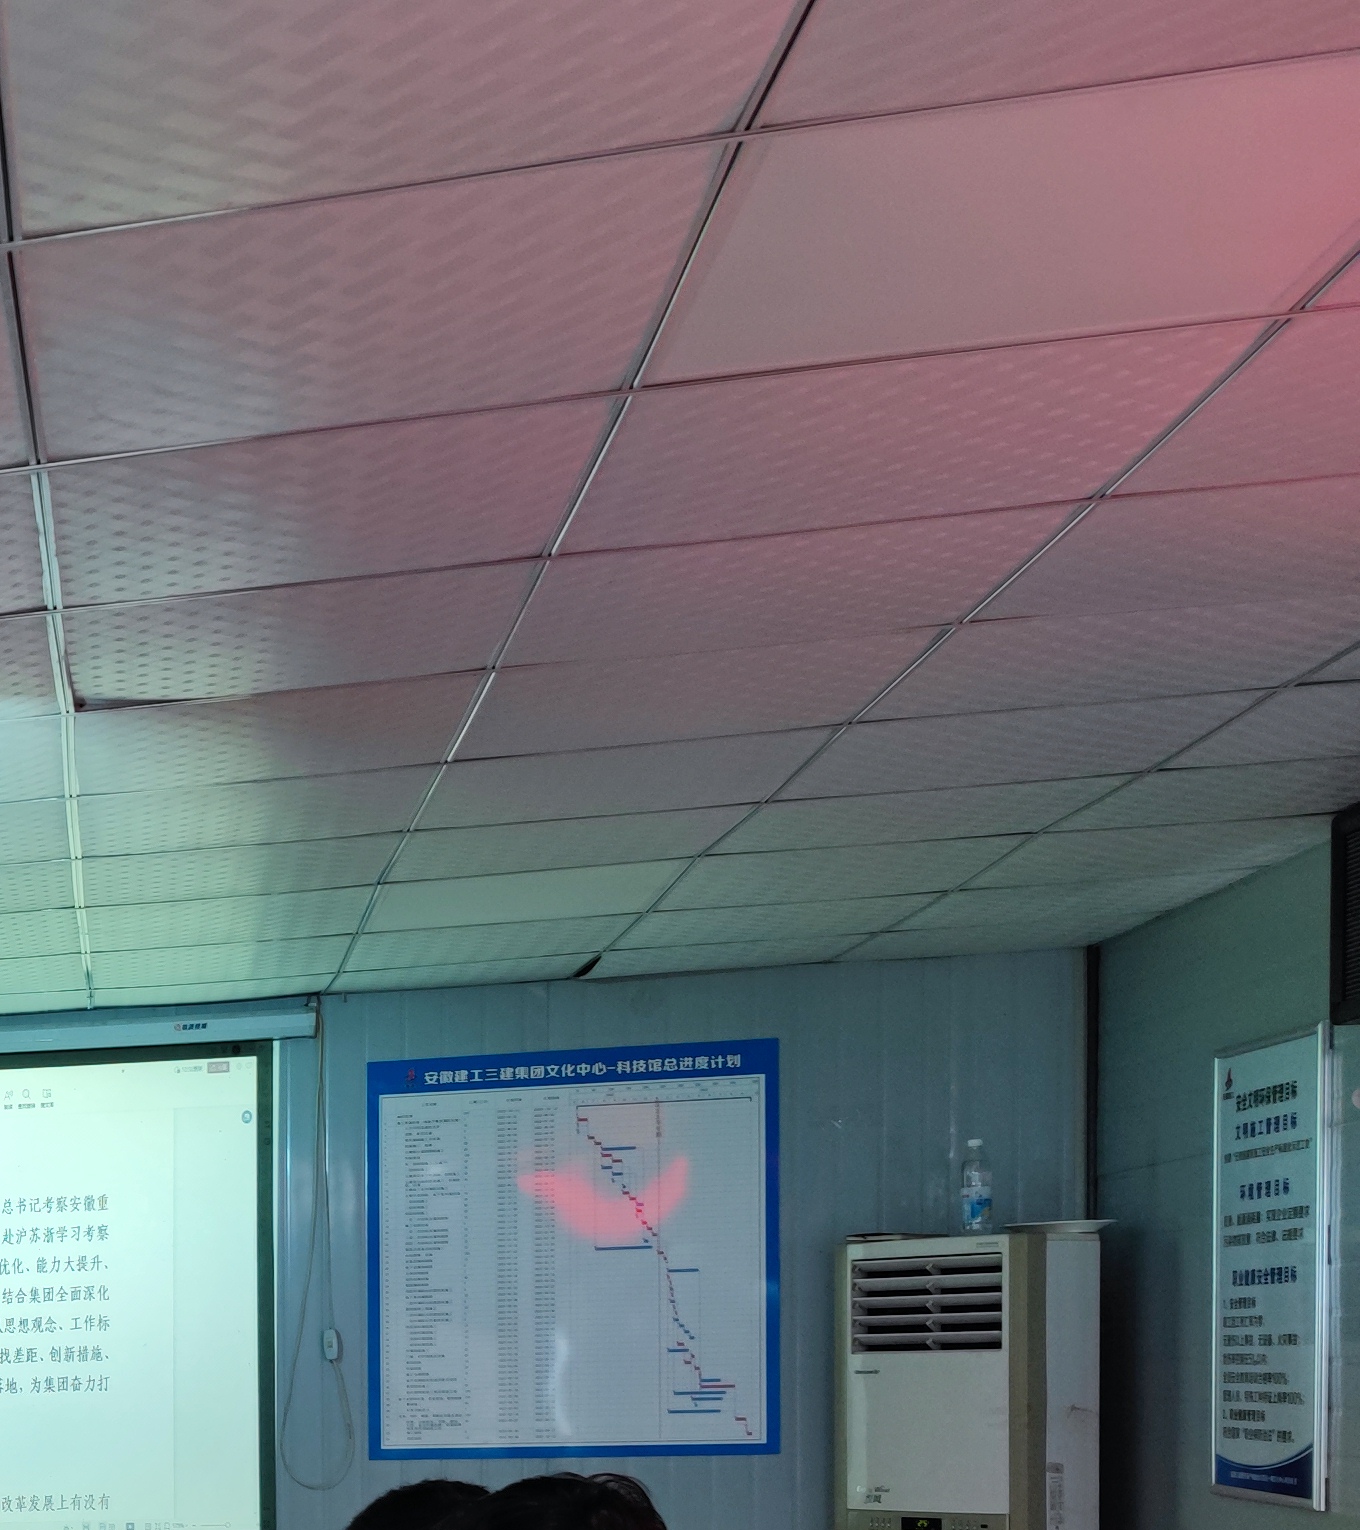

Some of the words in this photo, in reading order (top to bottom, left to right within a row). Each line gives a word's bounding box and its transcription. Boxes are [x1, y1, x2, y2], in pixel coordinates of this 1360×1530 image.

[424, 1054, 742, 1086] 安徽建工三建集团文化中心-科技馆总进度计划
